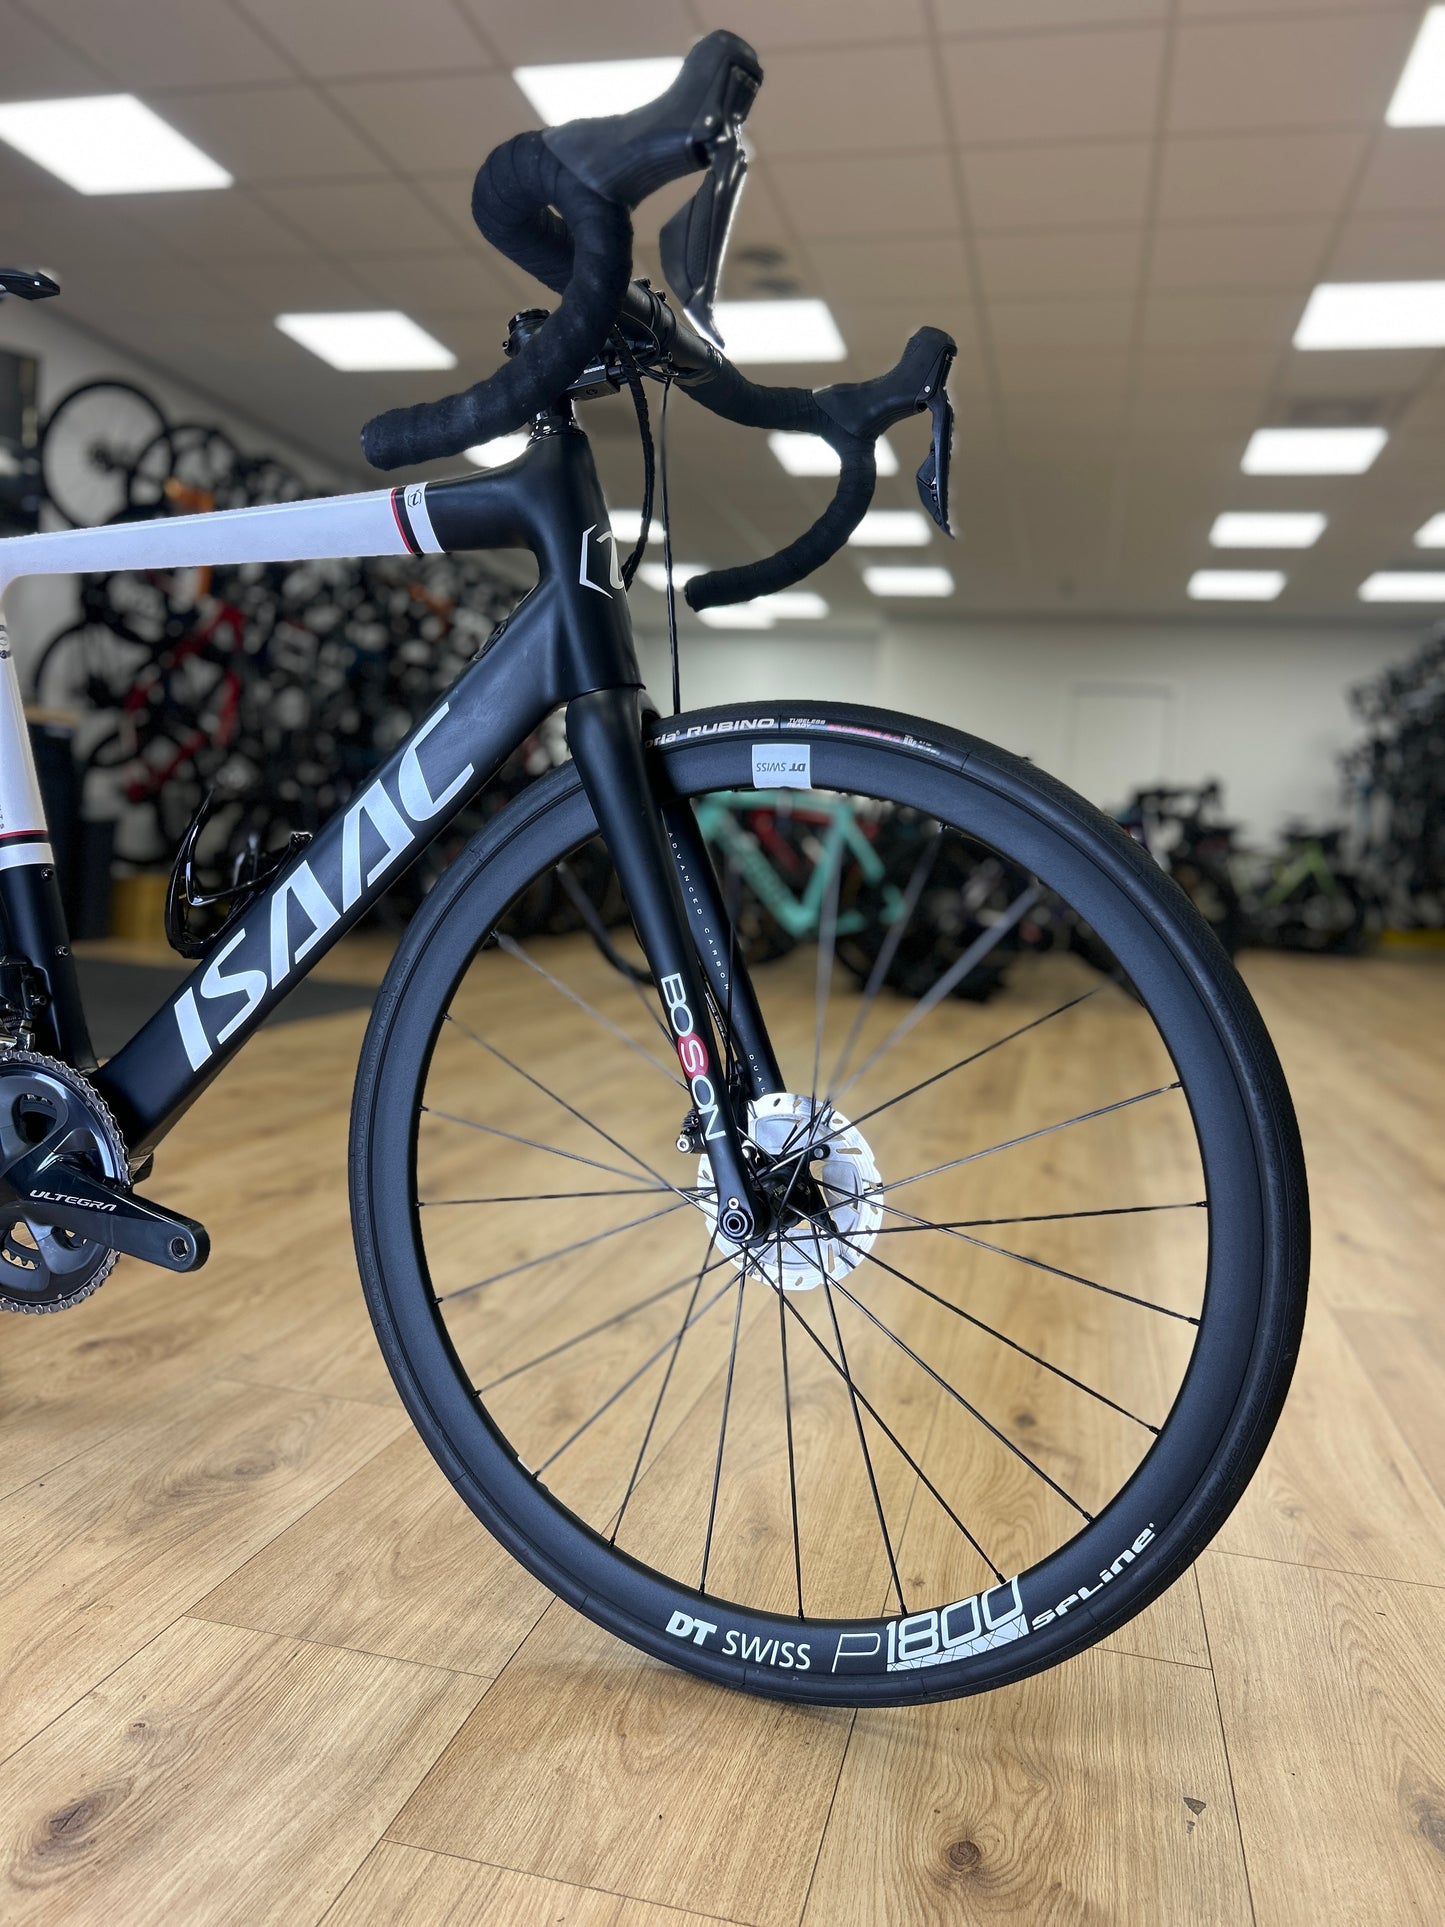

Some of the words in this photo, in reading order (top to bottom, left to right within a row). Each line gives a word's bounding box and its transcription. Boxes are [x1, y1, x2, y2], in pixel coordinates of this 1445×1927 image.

[686, 718, 776, 738] RUBINO
[756, 762, 786, 773] SWISS
[788, 762, 806, 772] DT
[173, 701, 475, 1073] ISAAC
[667, 831, 703, 915] ADVANCED
[704, 926, 730, 991] CARBON
[660, 972, 728, 1142] BOSON
[748, 1053, 766, 1093] DUAL
[29, 1189, 118, 1212] ULTEGRA
[664, 1610, 719, 1645] DT
[721, 1630, 812, 1671] SWISS
[831, 1574, 1026, 1674] P1800
